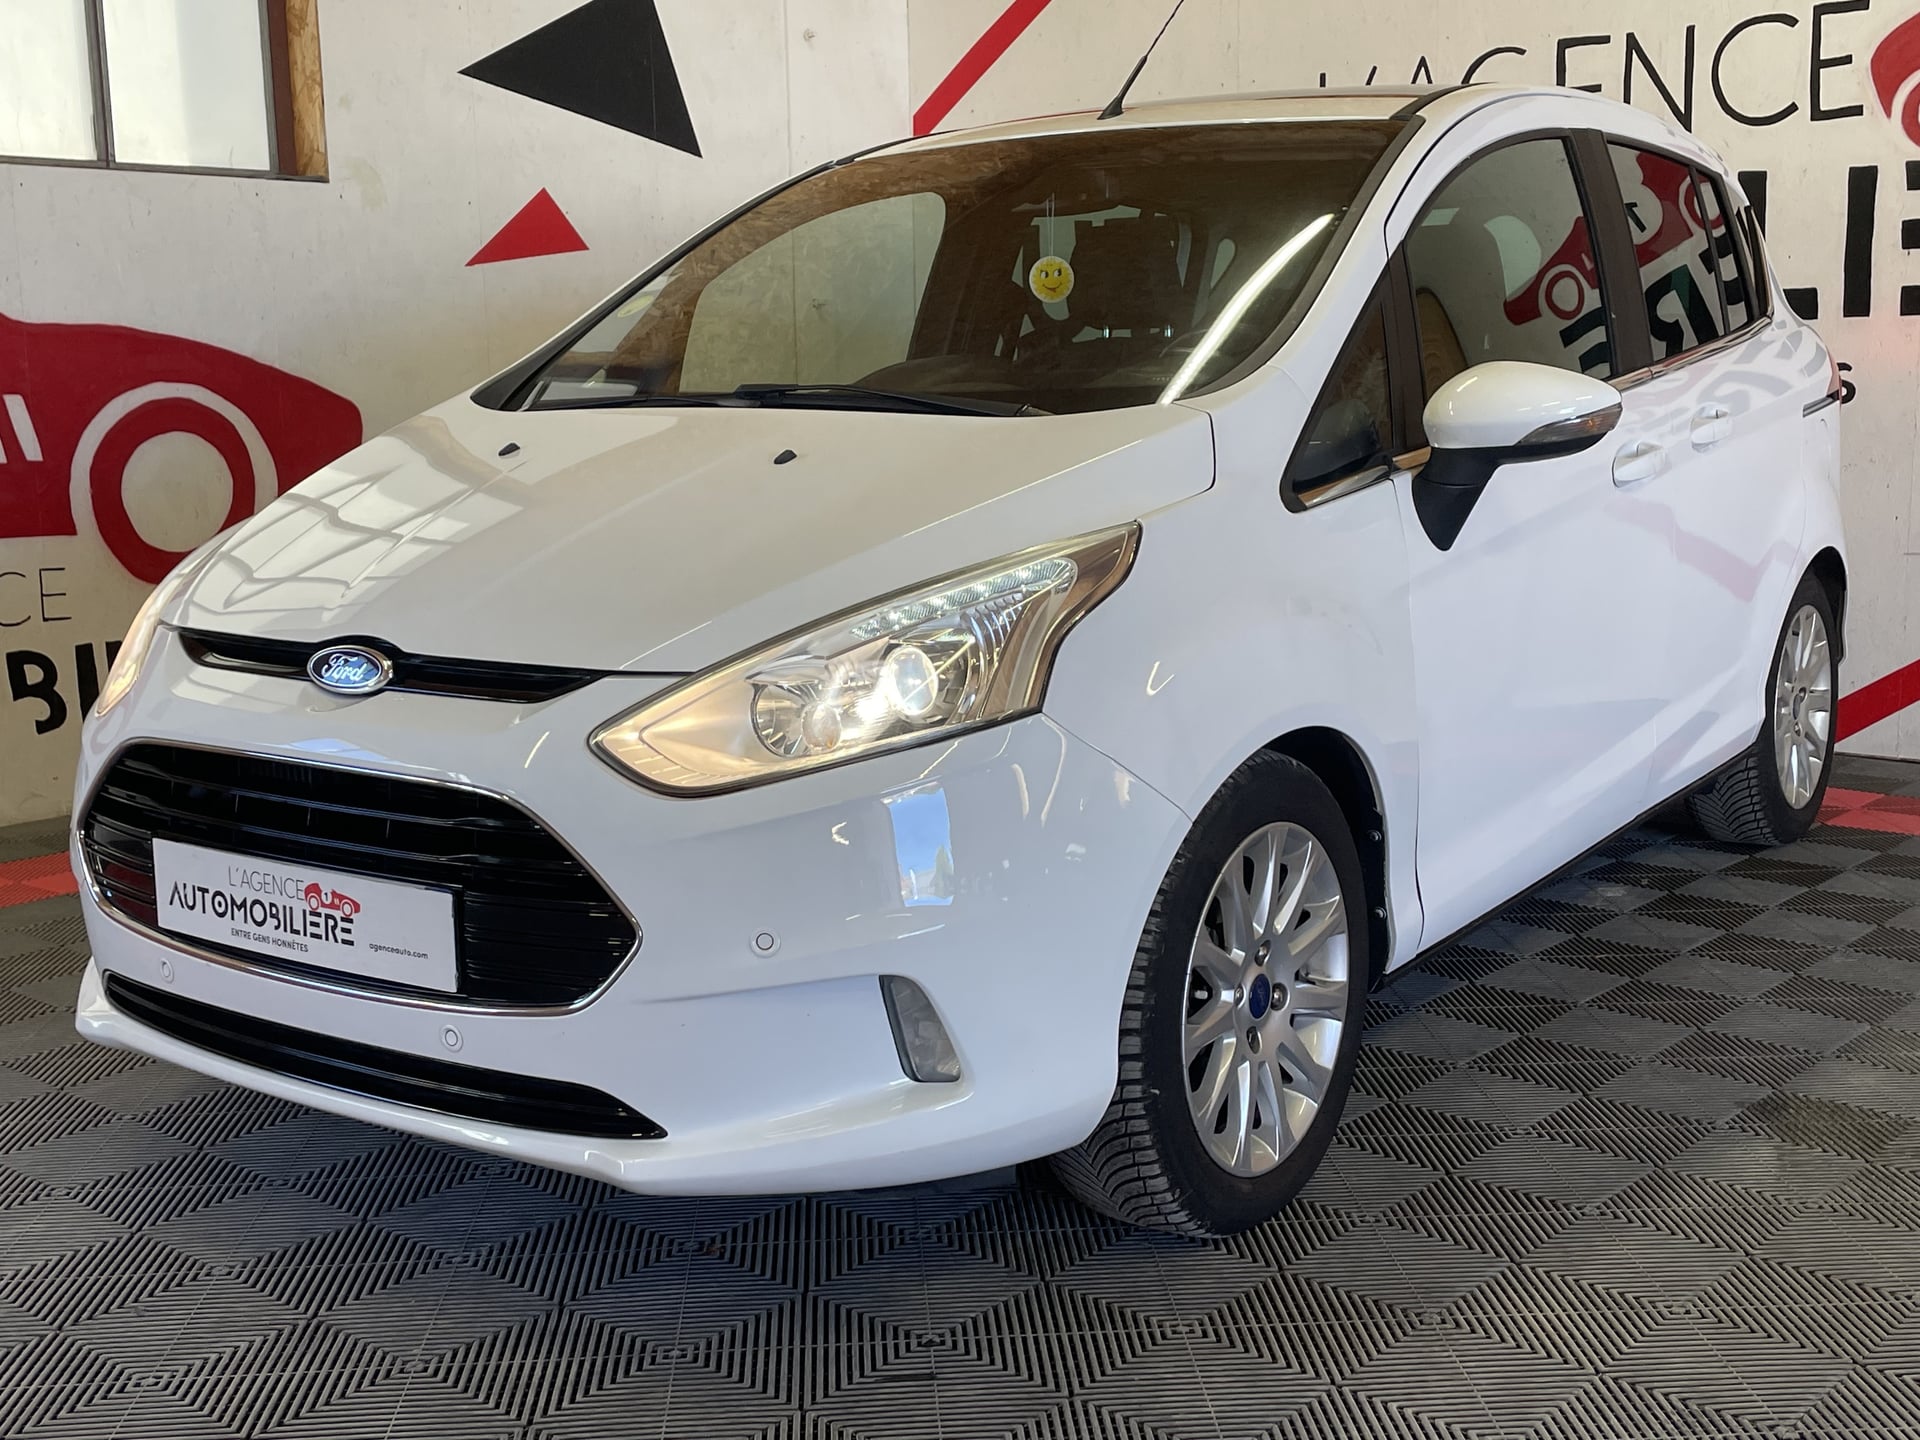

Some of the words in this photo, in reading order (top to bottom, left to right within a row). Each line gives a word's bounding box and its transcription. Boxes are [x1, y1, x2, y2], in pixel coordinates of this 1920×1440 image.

[321, 653, 367, 681] Ford
[228, 865, 305, 902] L'AGENCE
[231, 927, 252, 940] ENTRE
[252, 932, 271, 945] GENS
[368, 943, 429, 960] agenceauto.com
